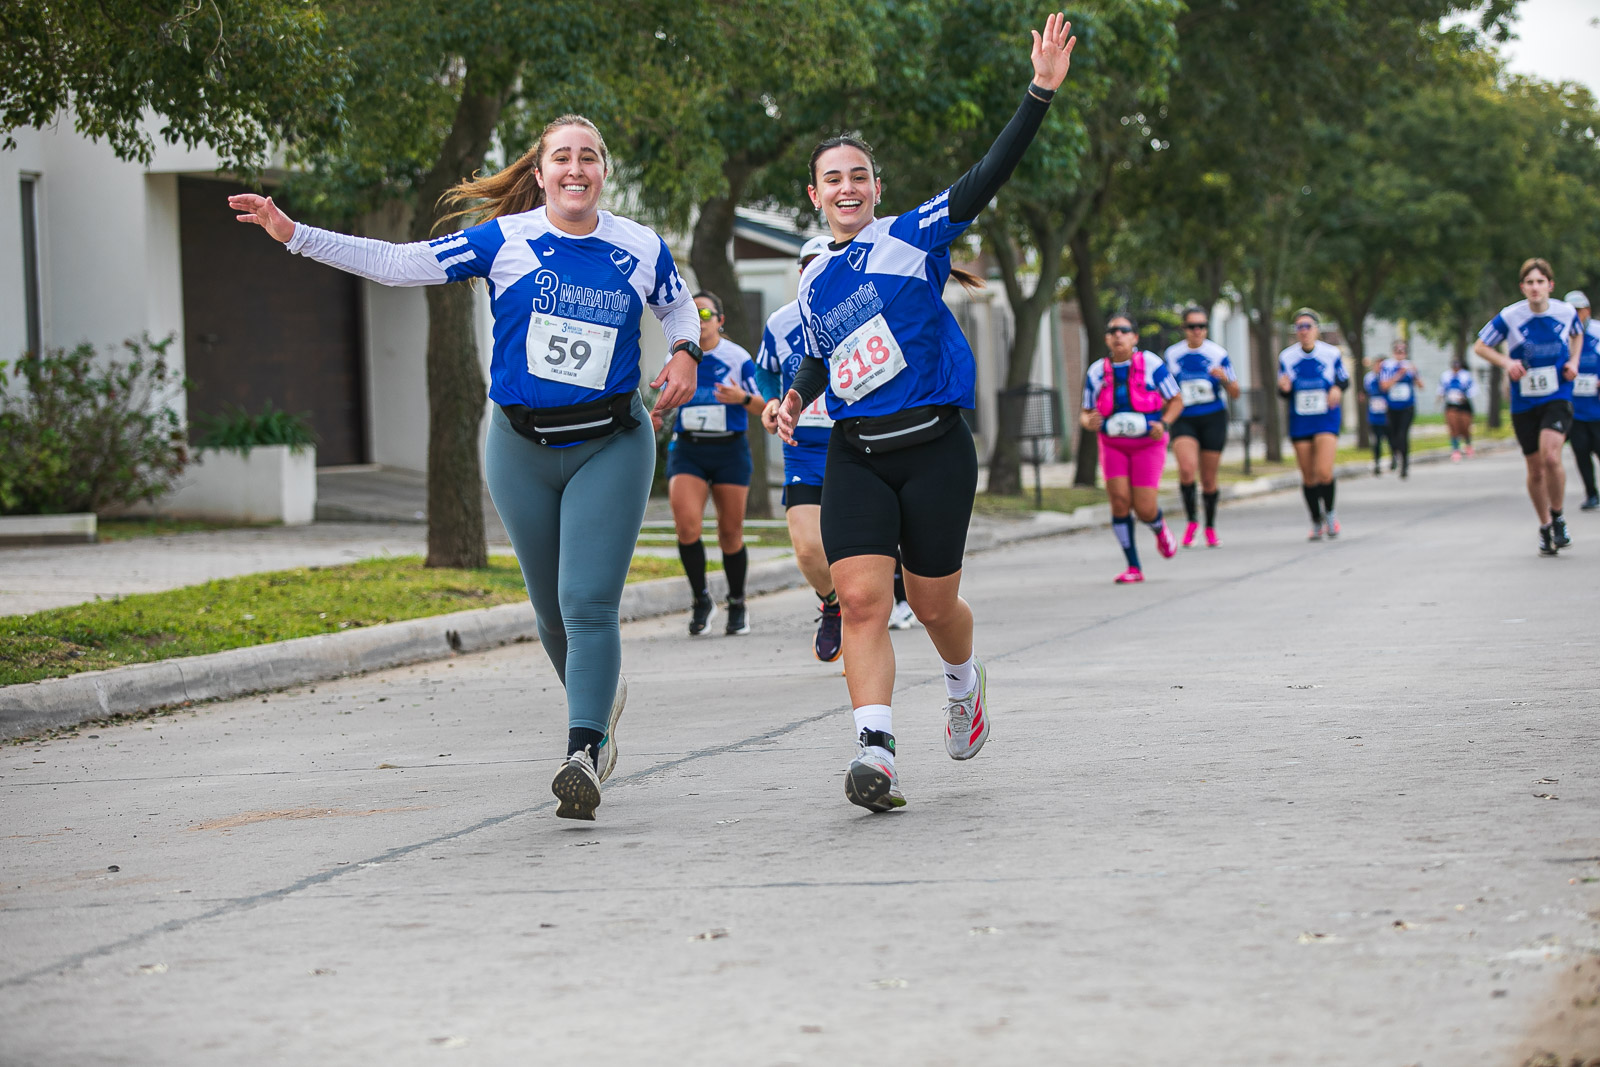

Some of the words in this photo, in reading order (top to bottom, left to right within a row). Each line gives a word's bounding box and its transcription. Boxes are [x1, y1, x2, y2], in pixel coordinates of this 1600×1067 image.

[533, 269, 559, 316] 3
[560, 283, 630, 313] MARATÓN
[822, 281, 879, 332] MARATÓN
[544, 335, 592, 370] 59
[811, 313, 836, 356] 3
[837, 336, 890, 389] 518
[698, 417, 707, 431] 7
